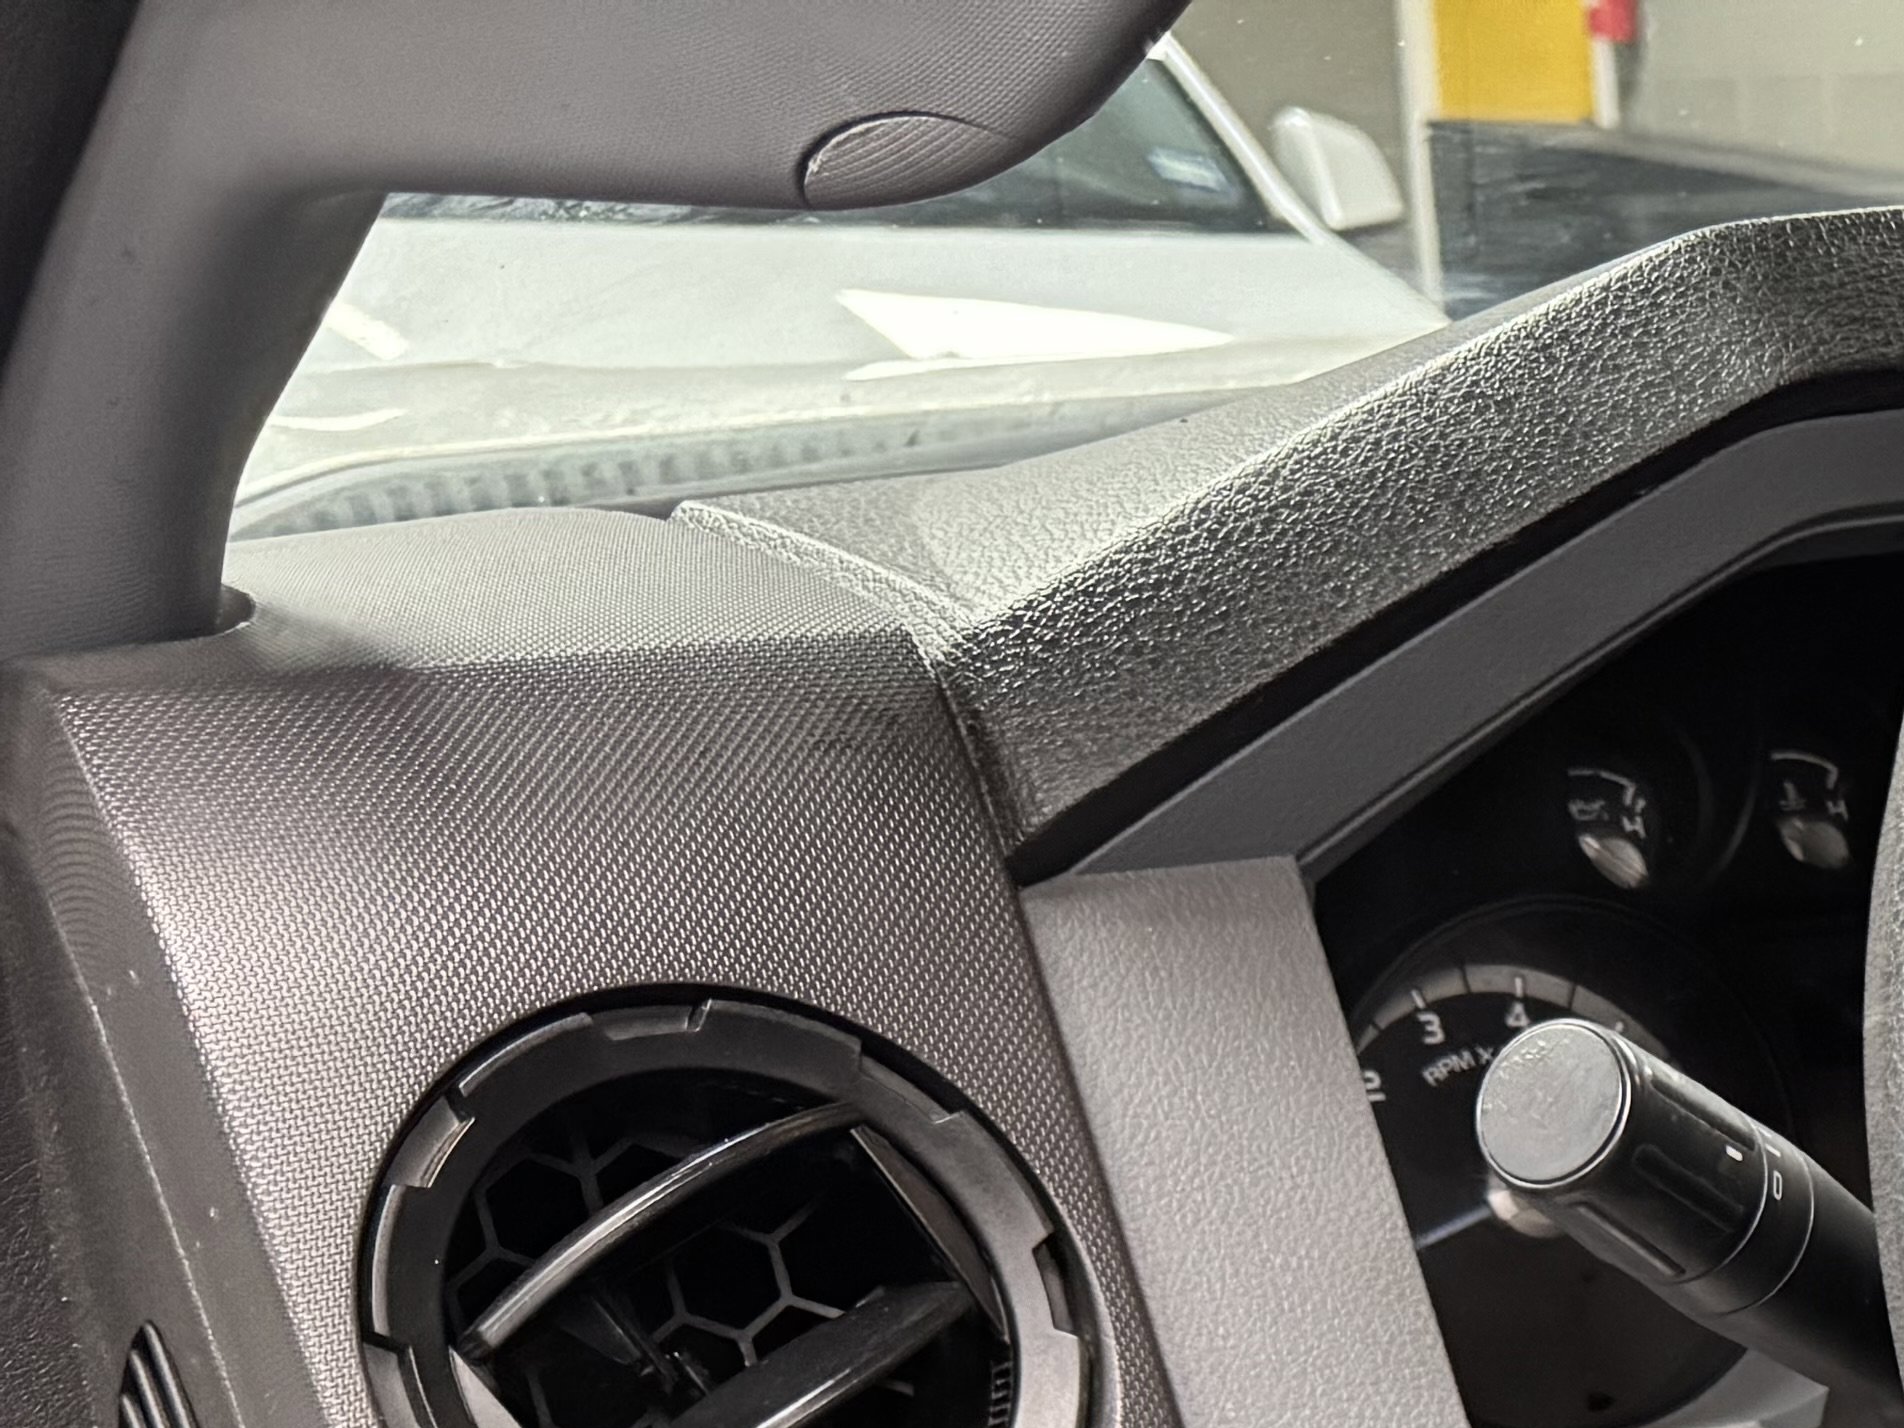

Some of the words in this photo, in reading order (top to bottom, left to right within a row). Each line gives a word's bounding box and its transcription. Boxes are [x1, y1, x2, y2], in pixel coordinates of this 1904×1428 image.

[1416, 1011, 1446, 1045] 3
[1422, 1048, 1477, 1087] RPM
[1362, 1069, 1387, 1102] 2
